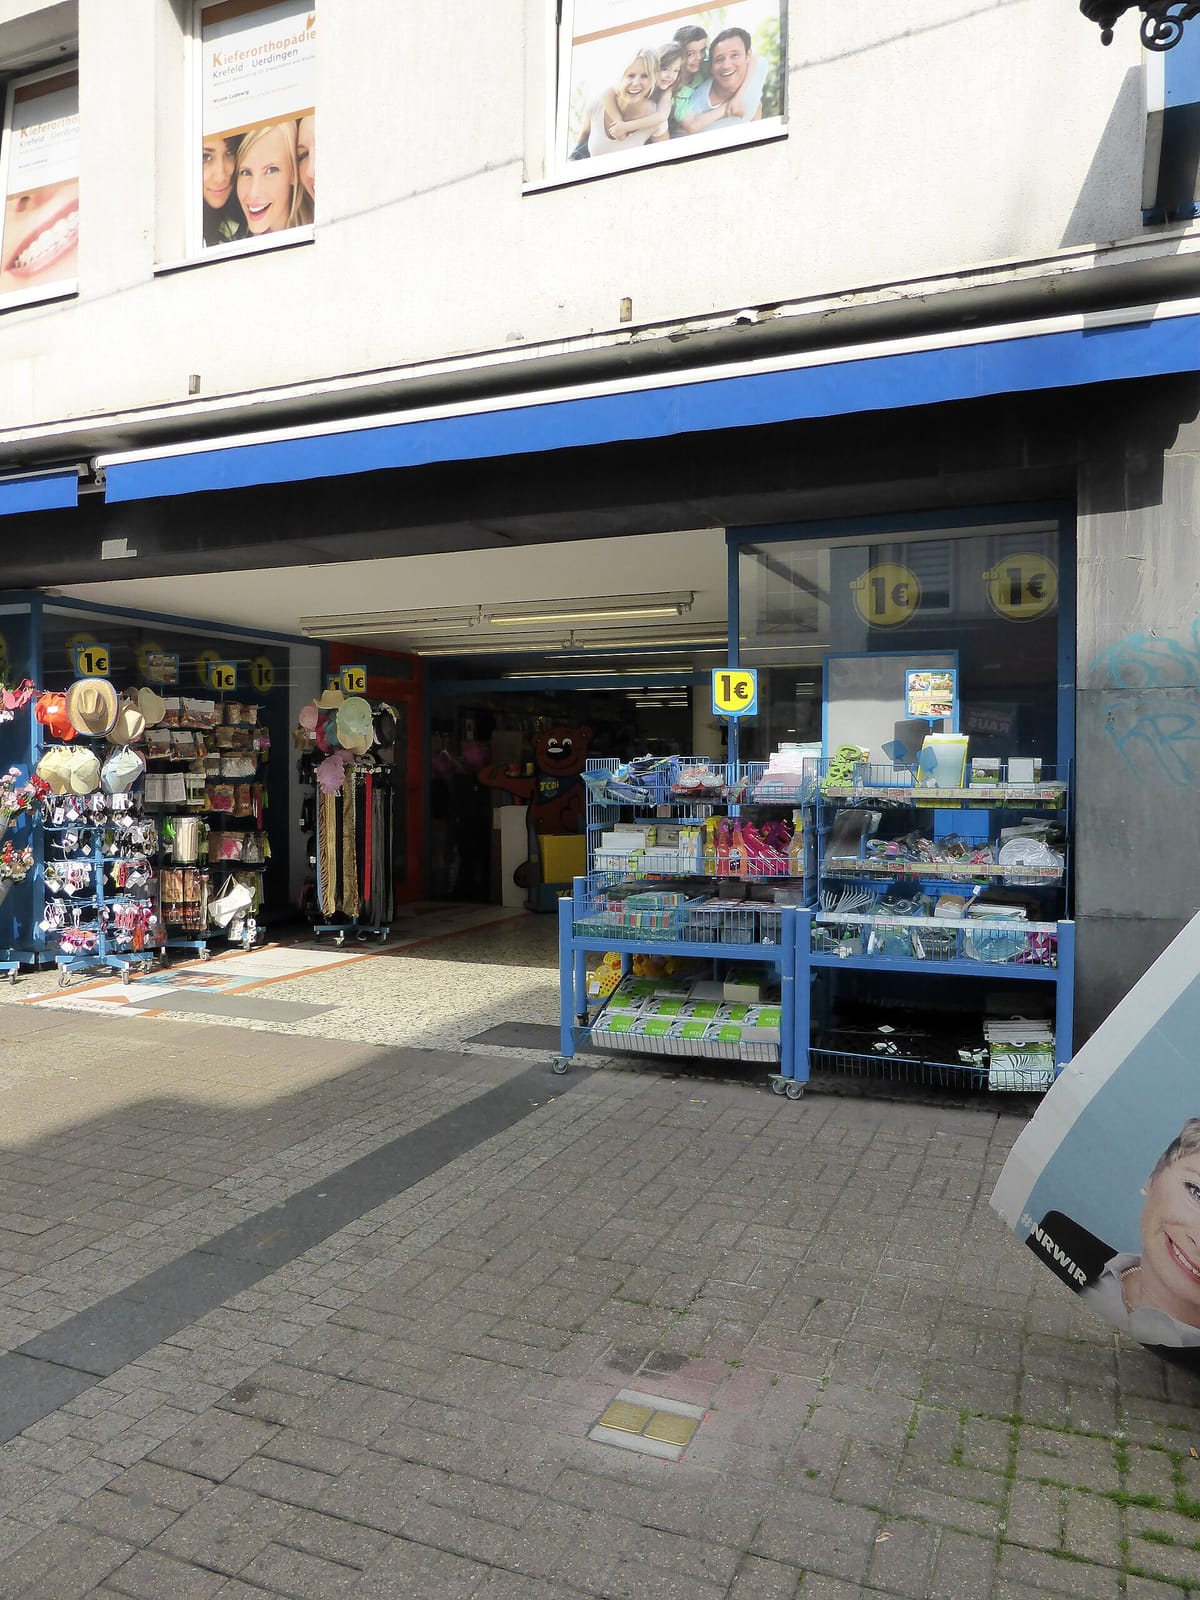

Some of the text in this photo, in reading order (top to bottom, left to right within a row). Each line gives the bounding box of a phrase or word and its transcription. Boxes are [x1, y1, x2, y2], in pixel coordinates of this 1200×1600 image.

[212, 63, 244, 79] Krefeld
[251, 48, 299, 68] Uerdingen
[721, 675, 748, 702] 1€
